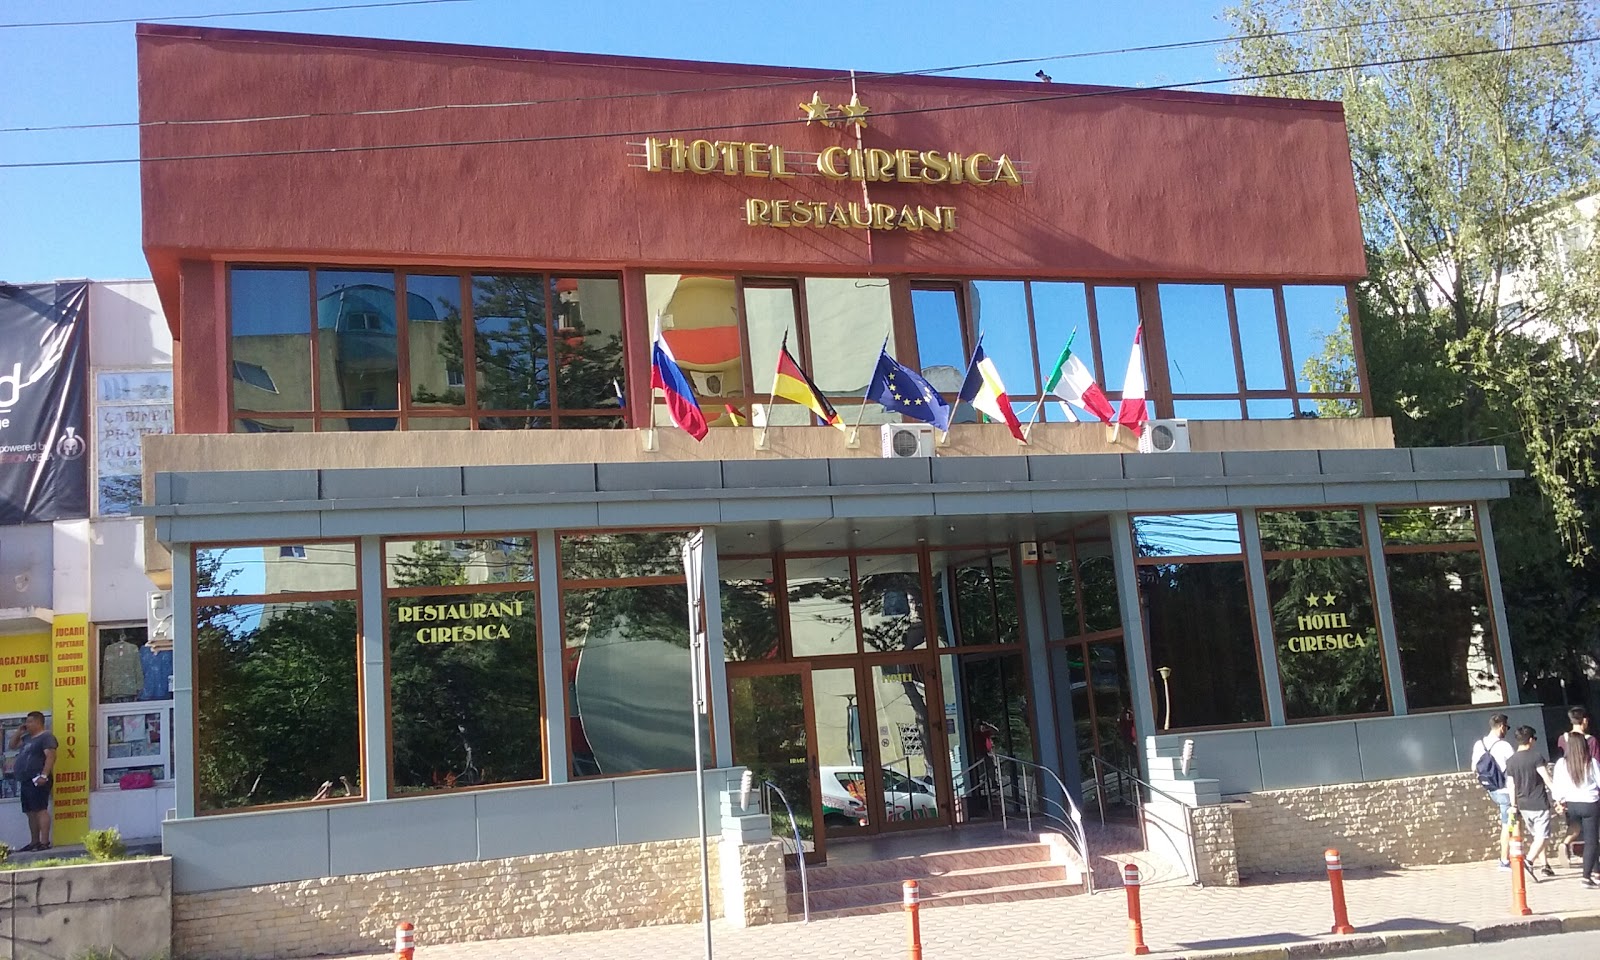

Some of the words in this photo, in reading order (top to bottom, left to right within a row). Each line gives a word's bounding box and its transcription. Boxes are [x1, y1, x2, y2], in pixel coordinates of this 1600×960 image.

[646, 137, 796, 180] HOTEL
[817, 146, 1023, 186] CIRESICA
[746, 198, 957, 232] RESTAURANT
[397, 601, 524, 623] RESTAURANT
[1297, 612, 1351, 631] HOTEL
[55, 626, 85, 637] JUCARII
[416, 624, 511, 644] CIRESICA
[1288, 633, 1365, 653] CIRESICA
[15, 669, 26, 678] CU
[55, 676, 86, 687] LENJERII
[2, 683, 12, 693] DE
[14, 681, 39, 692] TOATE
[67, 698, 76, 759] XEROX
[56, 771, 87, 783] BATERII
